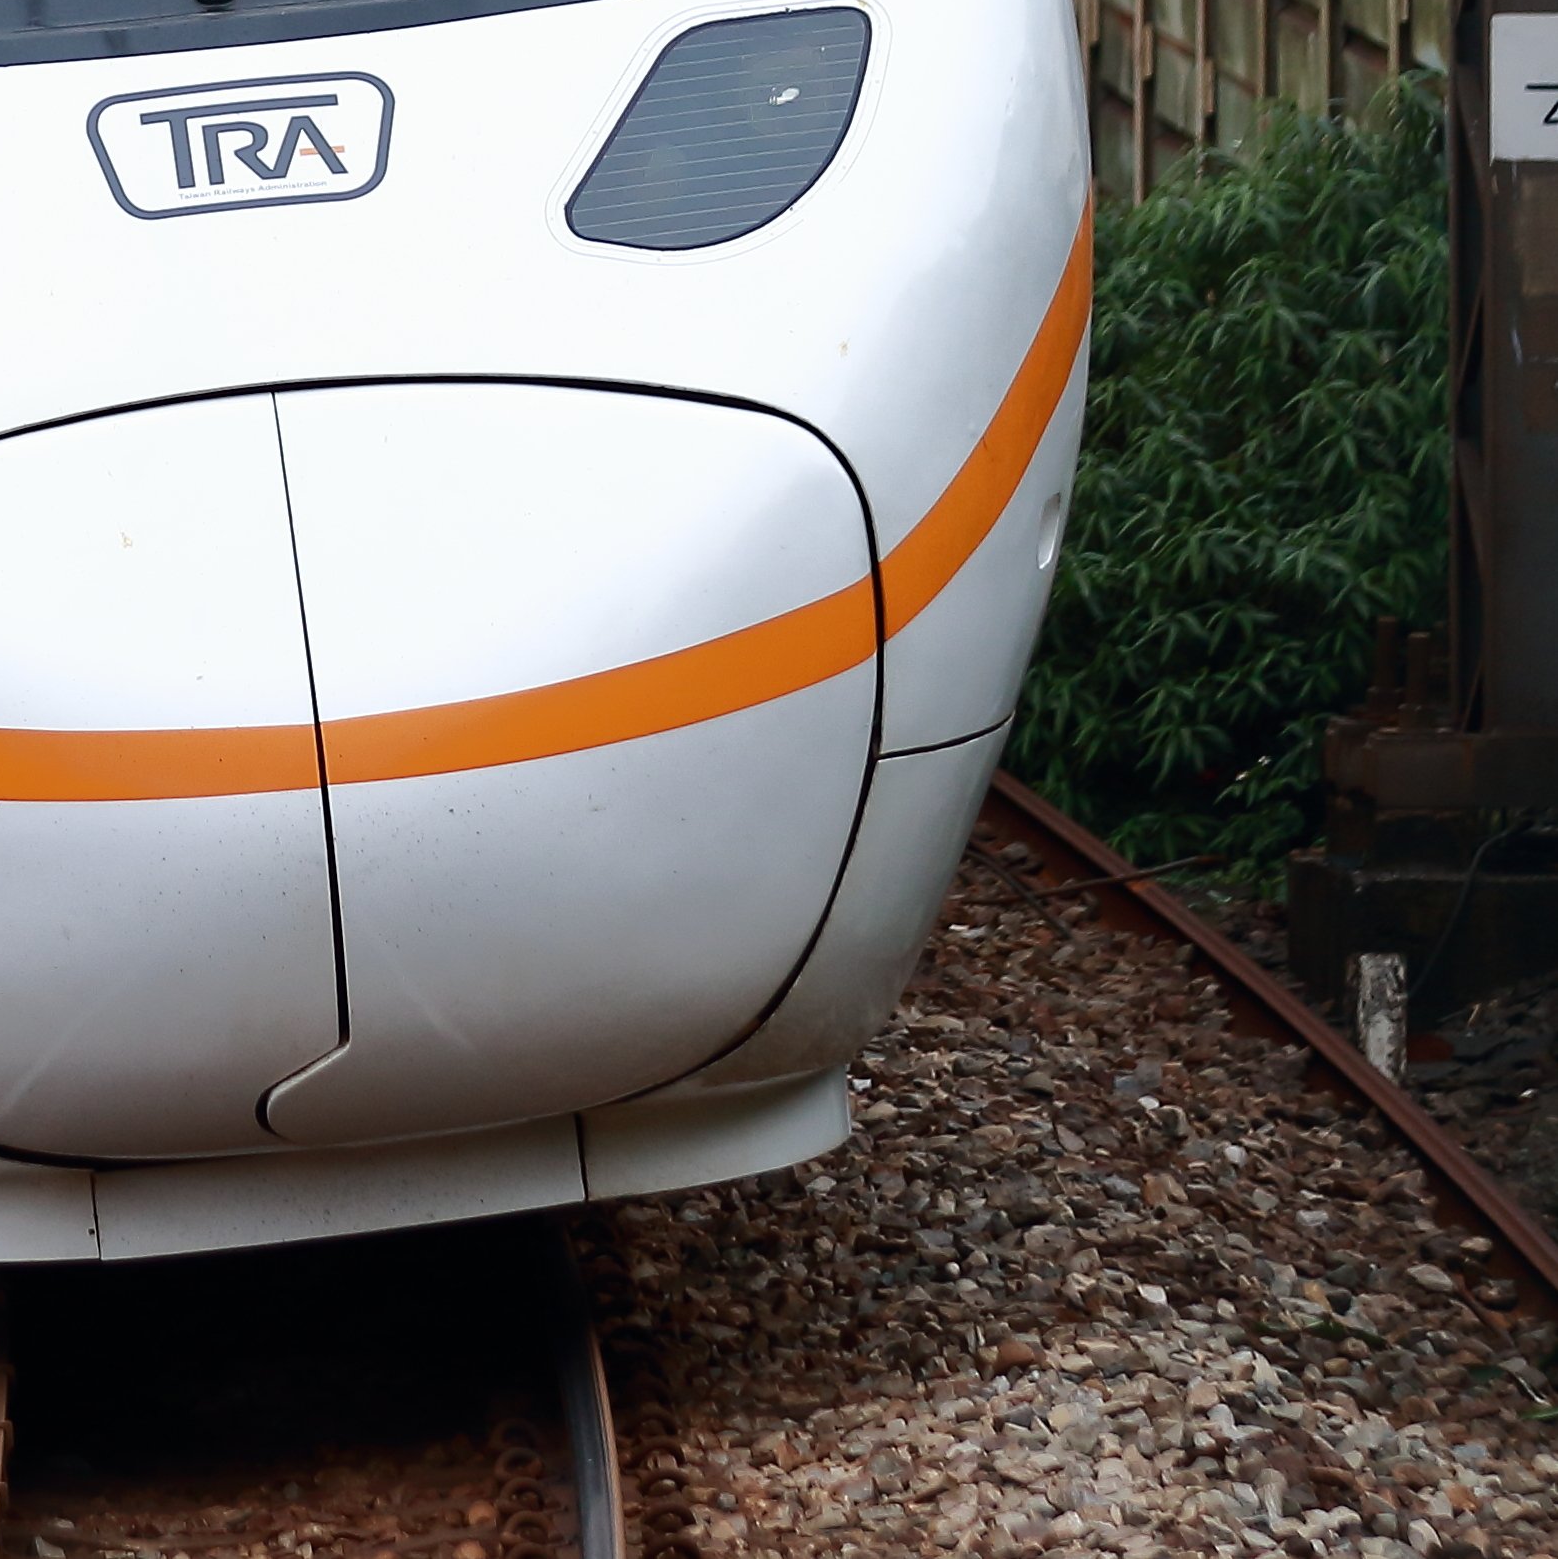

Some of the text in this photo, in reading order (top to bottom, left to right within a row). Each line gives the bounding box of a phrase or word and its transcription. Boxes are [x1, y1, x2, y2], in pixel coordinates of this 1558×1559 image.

[140, 94, 348, 189] TRA
[179, 180, 328, 200] Taiwan Railways Administration
